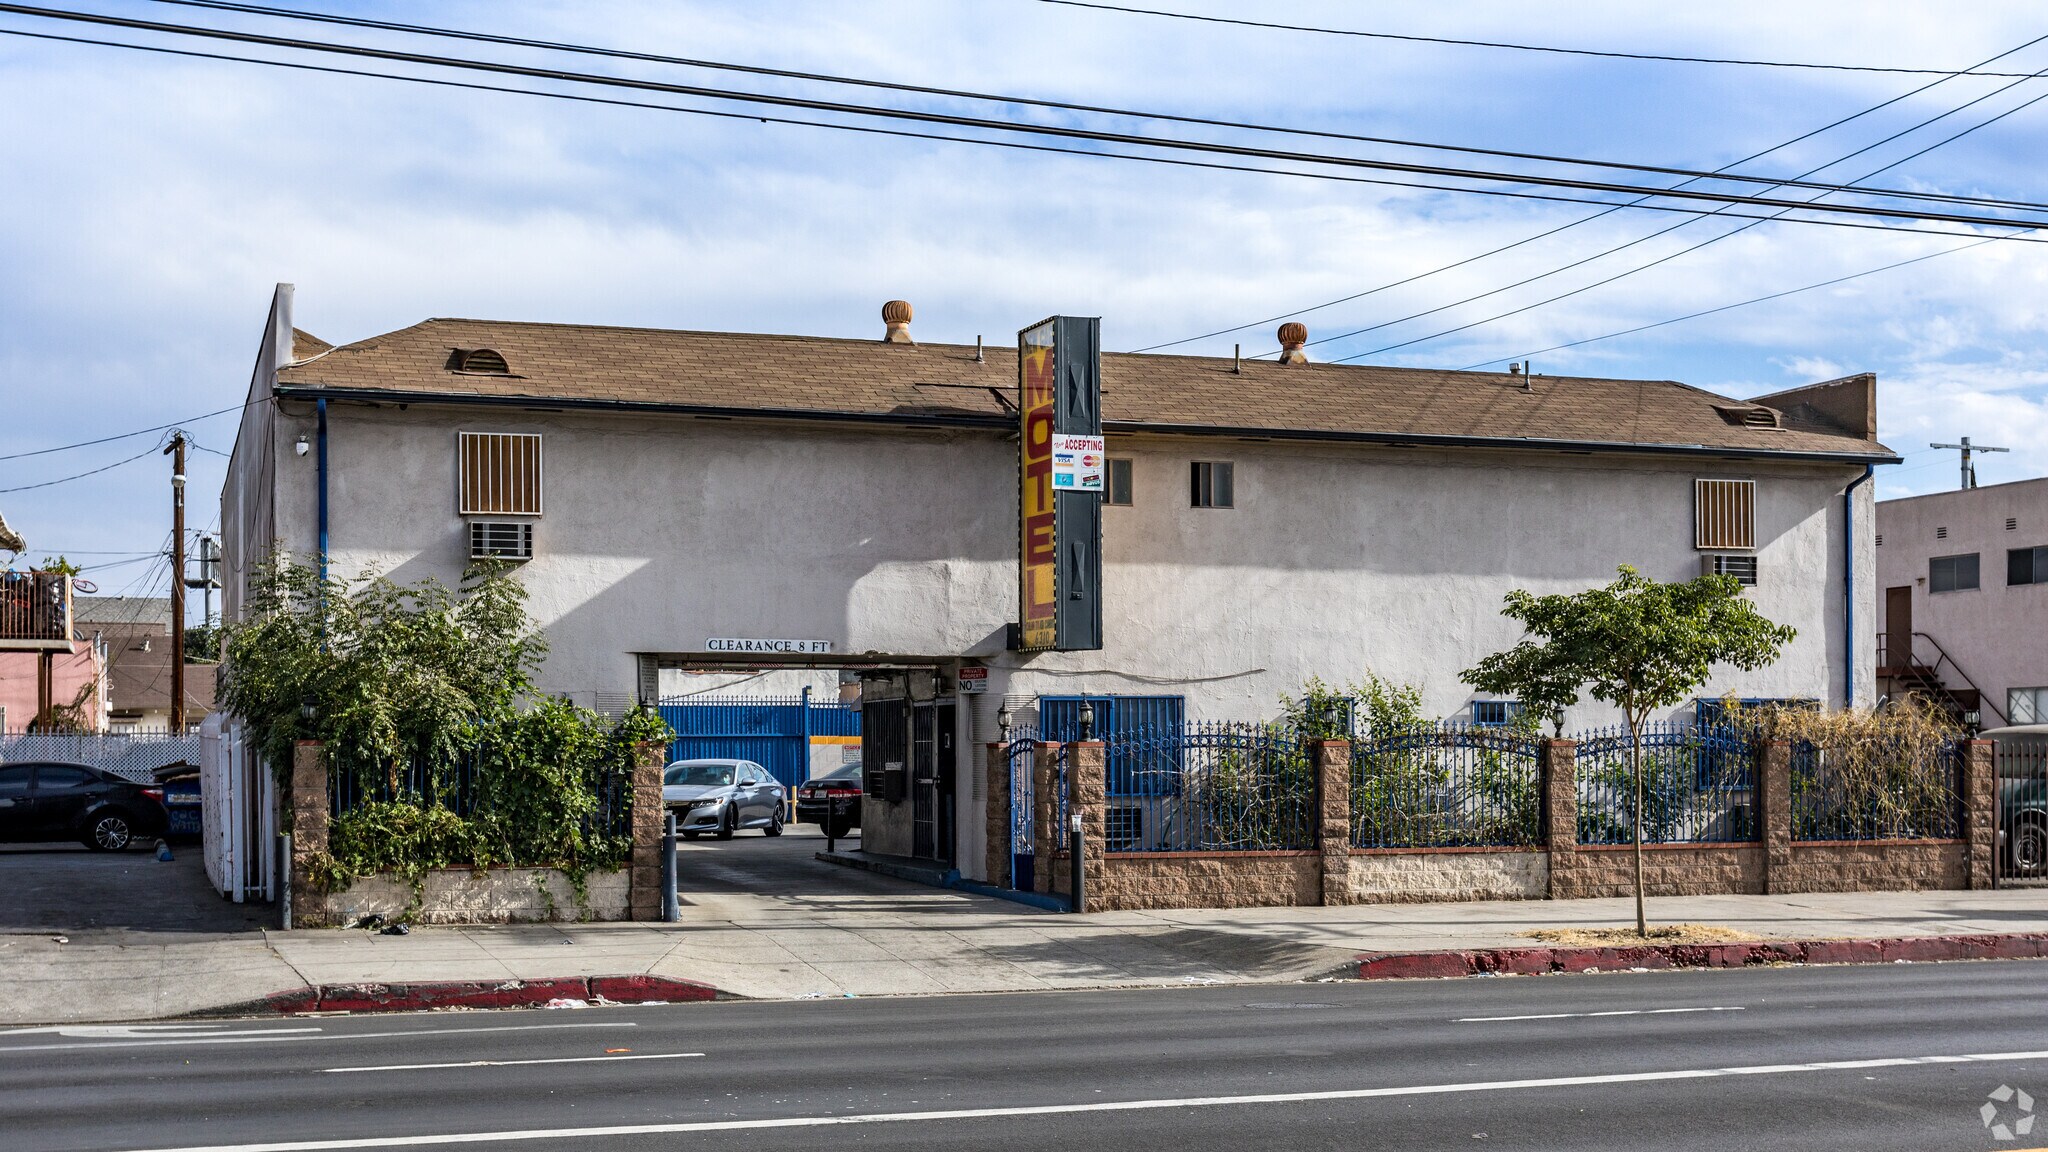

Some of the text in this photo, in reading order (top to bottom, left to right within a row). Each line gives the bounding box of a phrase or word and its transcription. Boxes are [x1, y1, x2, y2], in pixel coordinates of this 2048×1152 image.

[1065, 439, 1102, 451] ACCEPTING
[1026, 347, 1054, 620] MOTEL
[708, 639, 828, 652] CLEARANCE 8 FT
[960, 680, 972, 690] NO
